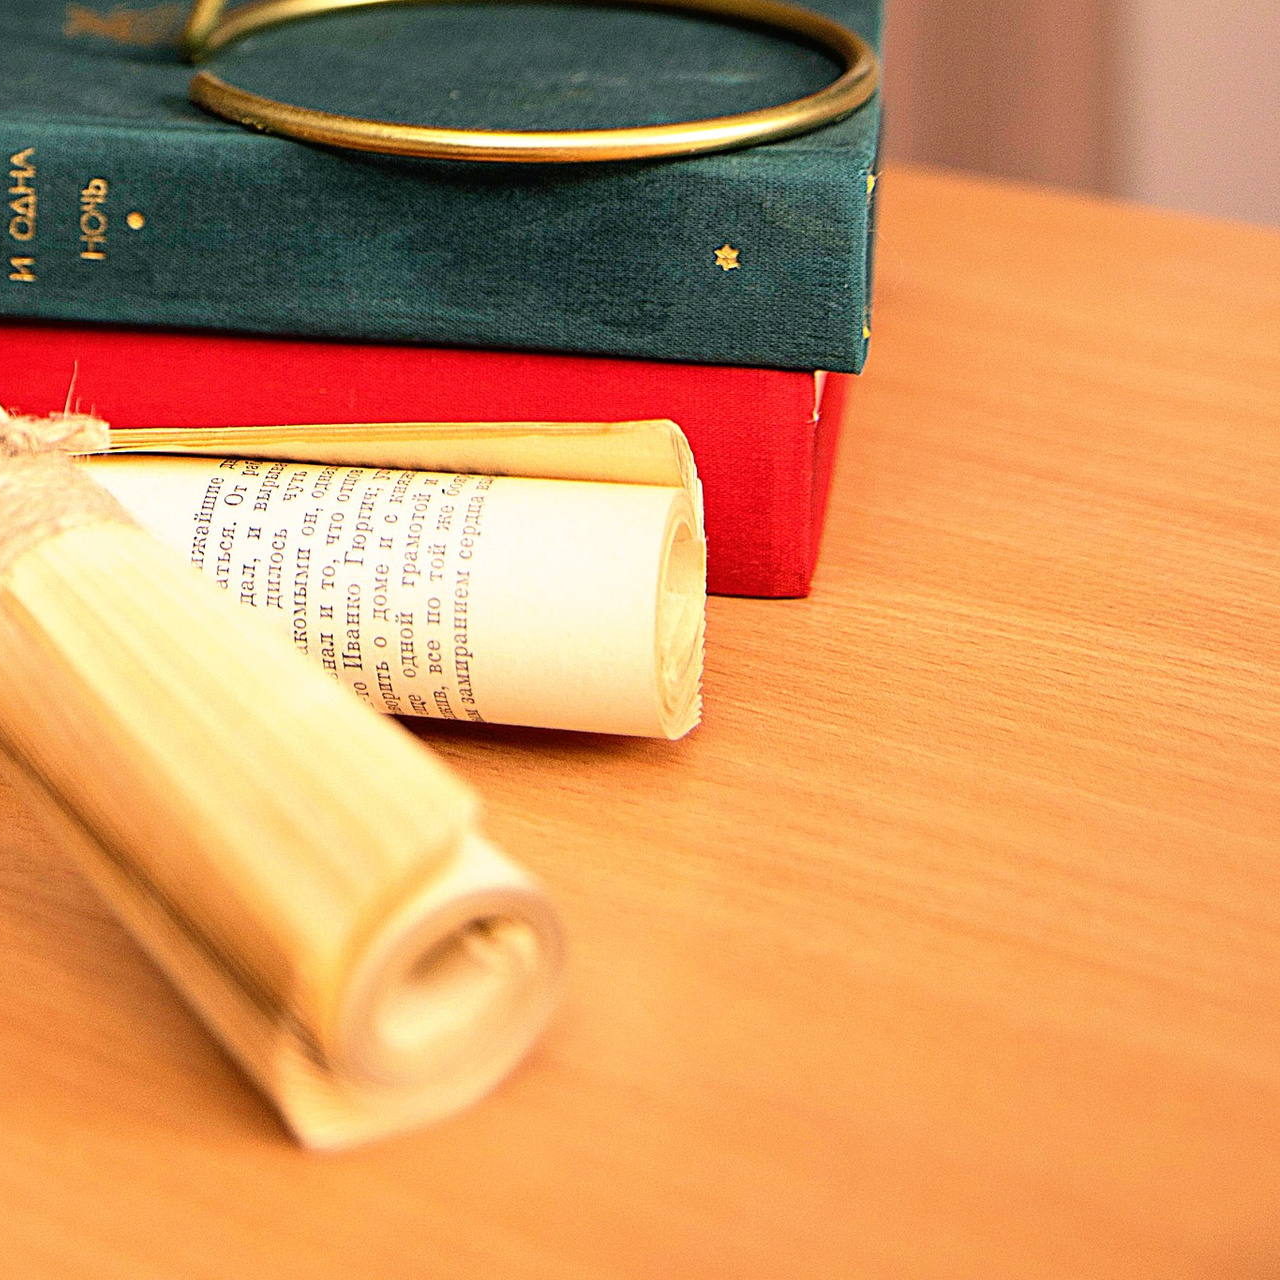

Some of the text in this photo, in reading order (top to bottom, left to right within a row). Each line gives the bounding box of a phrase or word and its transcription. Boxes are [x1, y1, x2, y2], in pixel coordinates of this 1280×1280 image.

[8, 146, 37, 282] И ОДНА
[80, 178, 108, 260] НОЧЬ
[224, 485, 248, 506] От
[266, 471, 307, 609] дилось чуть
[302, 508, 323, 536] он,
[240, 527, 261, 607] дал, и
[319, 513, 344, 619] и то, что
[341, 487, 384, 670] Иванко Гюргич;
[373, 514, 398, 648] о доме и с
[395, 493, 431, 678] одной грамотой
[426, 505, 454, 674] все по той же
[453, 496, 486, 704] замиранием сердца
